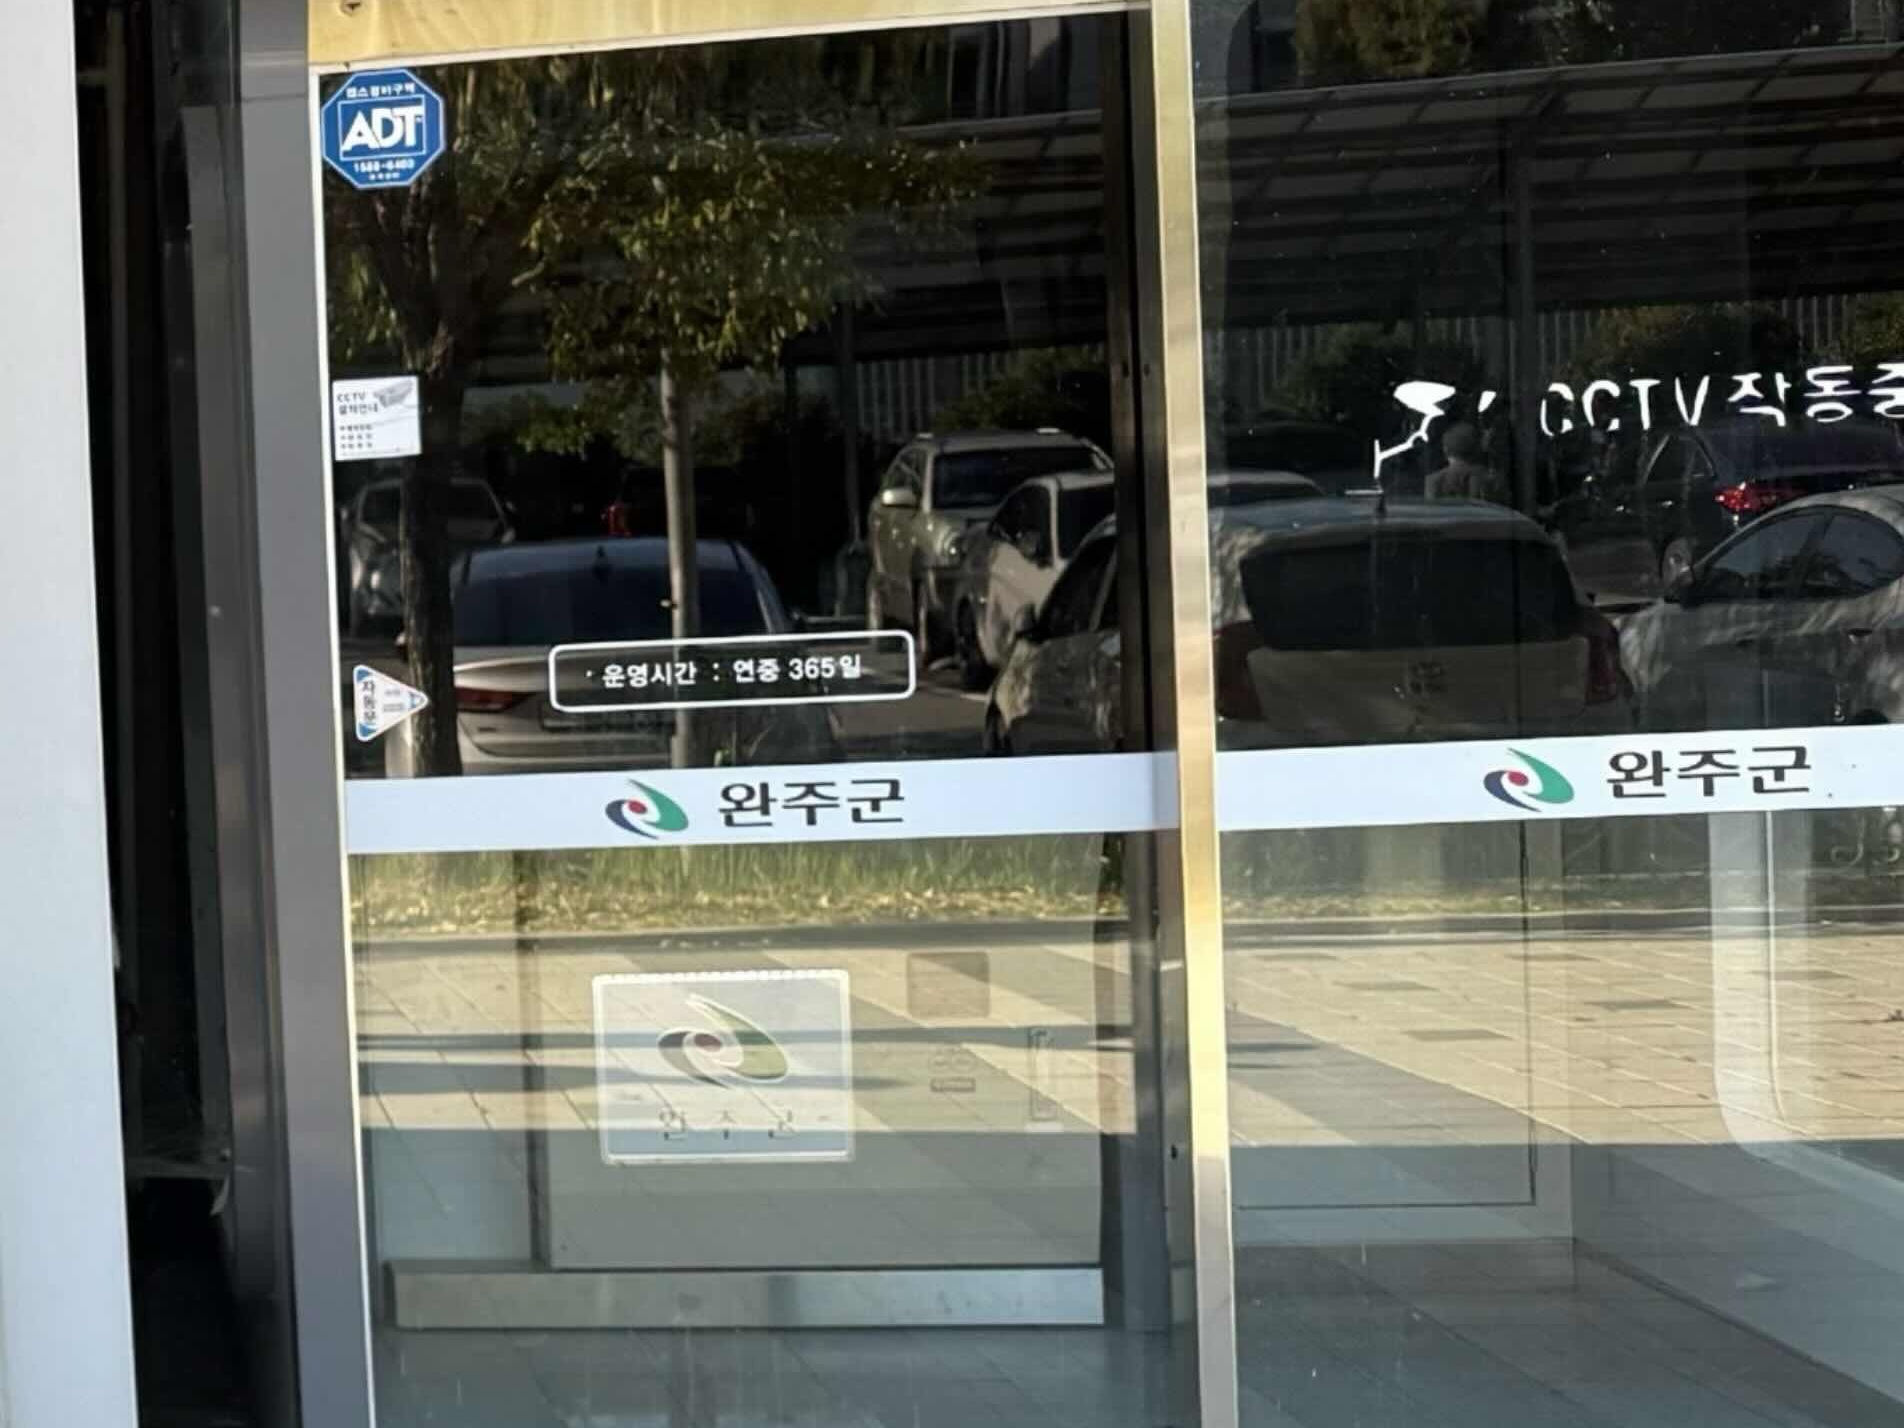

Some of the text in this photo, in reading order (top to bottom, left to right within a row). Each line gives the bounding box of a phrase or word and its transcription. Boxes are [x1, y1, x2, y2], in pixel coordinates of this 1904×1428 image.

[341, 106, 424, 151] ADT
[1540, 375, 1710, 436] CCTV
[602, 661, 697, 688] 운영시간
[733, 658, 780, 683] 연중
[789, 654, 862, 681] 365일
[1607, 746, 1812, 800] 완주군
[719, 779, 905, 828] 완주군
